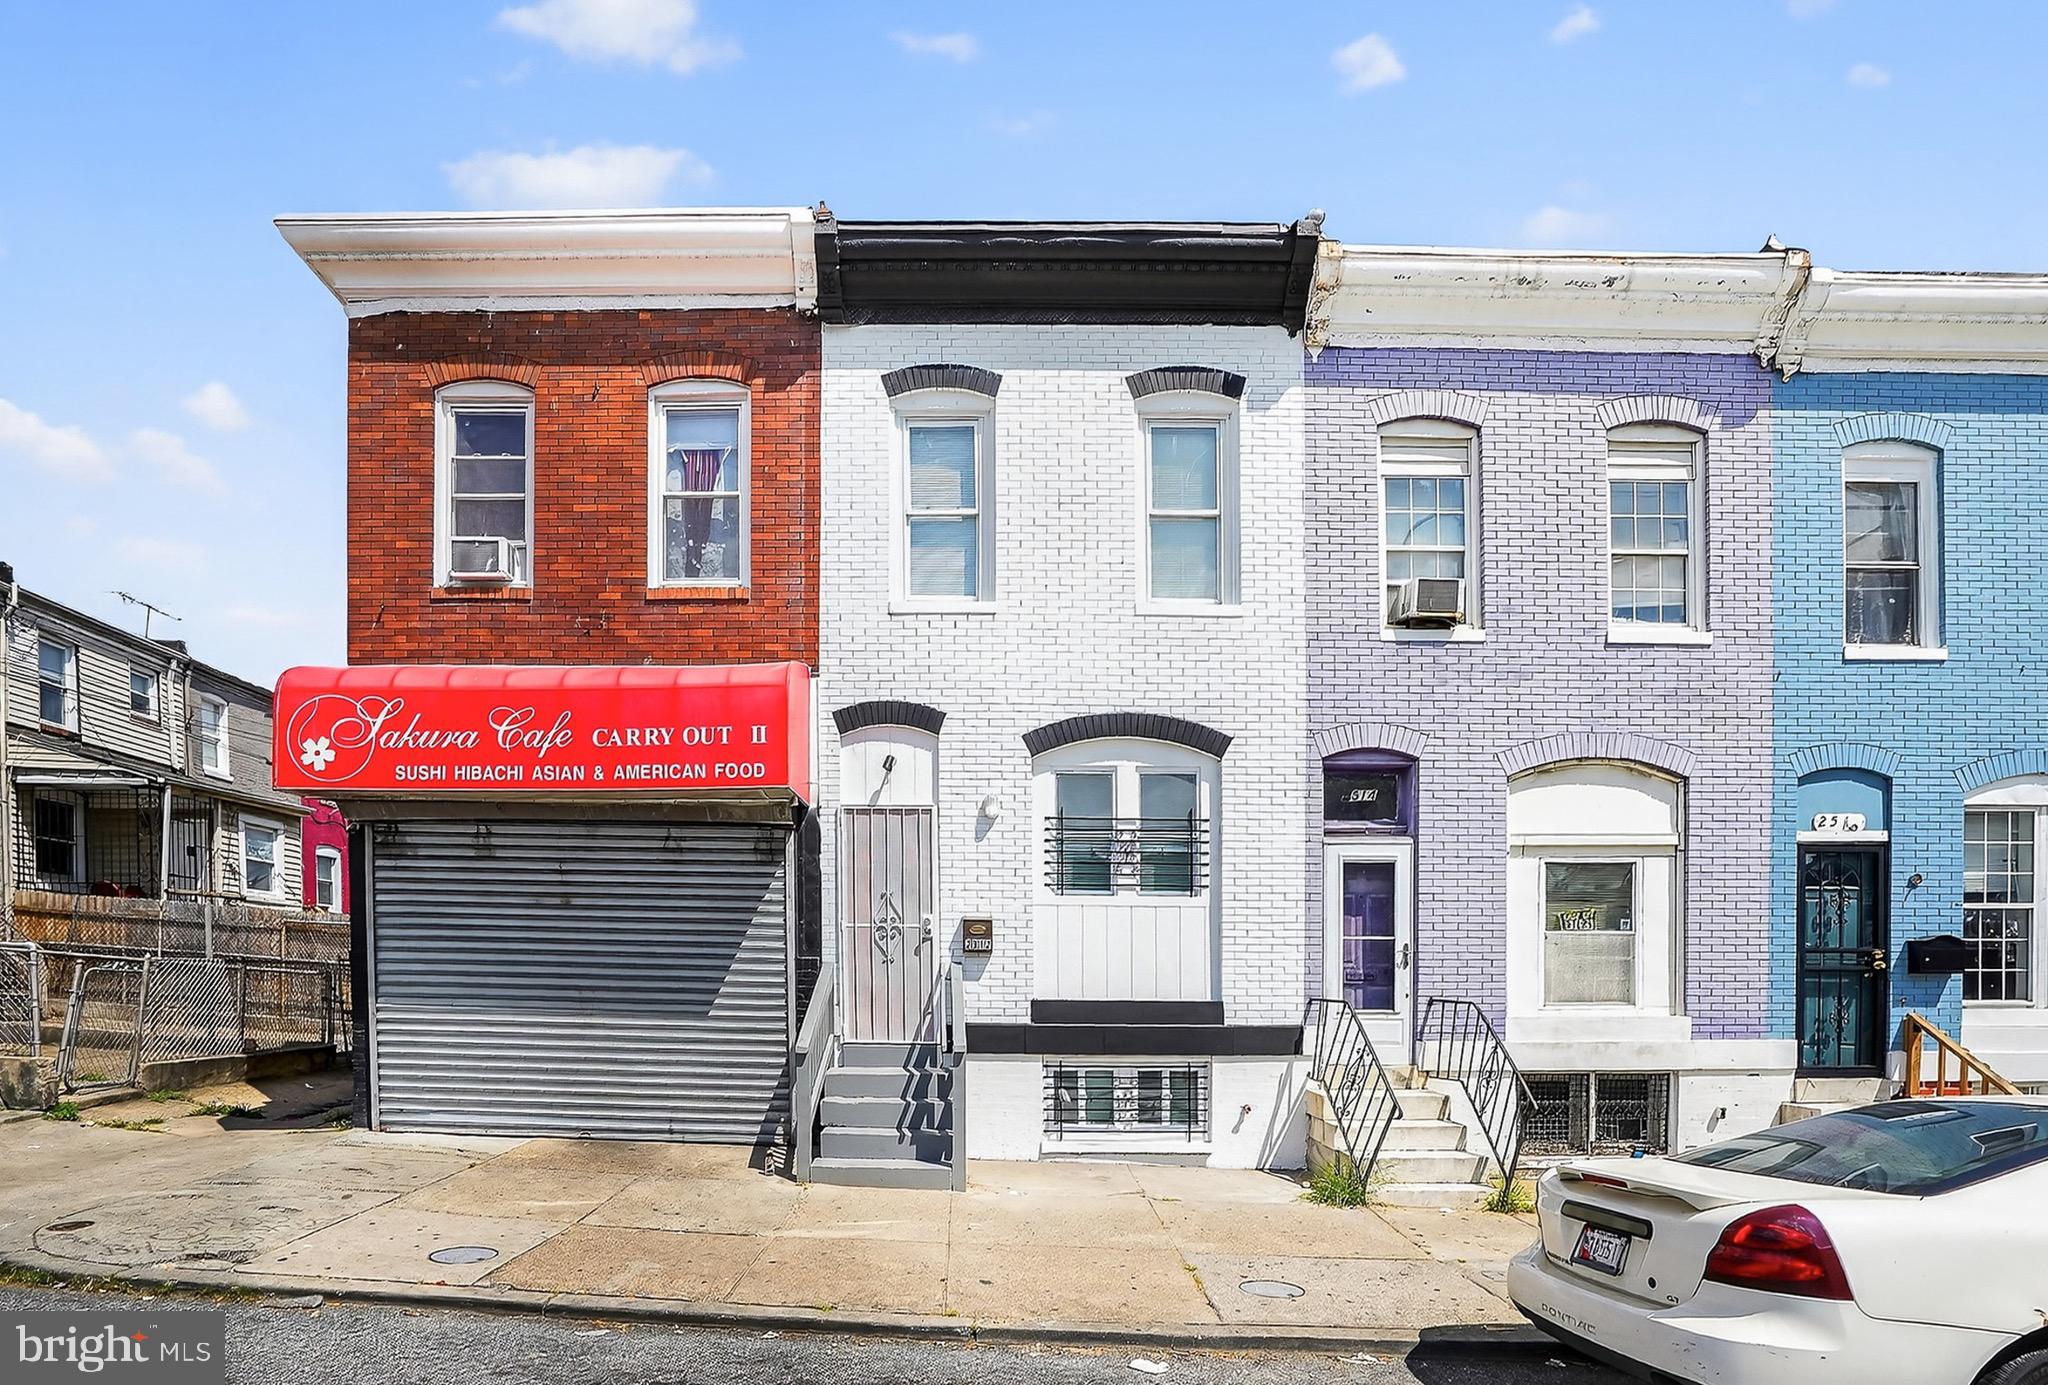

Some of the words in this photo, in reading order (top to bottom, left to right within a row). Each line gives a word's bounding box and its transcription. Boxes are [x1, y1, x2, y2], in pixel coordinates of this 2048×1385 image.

[331, 696, 480, 749] Sakura
[489, 706, 574, 758] Cafe
[592, 726, 675, 747] CARRY
[682, 725, 733, 745] OUT
[395, 765, 447, 781] SUSHI
[454, 765, 524, 781] HIBACHI
[531, 765, 585, 781] ASIAN
[593, 765, 605, 780] &
[613, 764, 707, 780] AMERICAN
[715, 763, 766, 778] FOOD
[1541, 1303, 1597, 1336] PONTIAC
